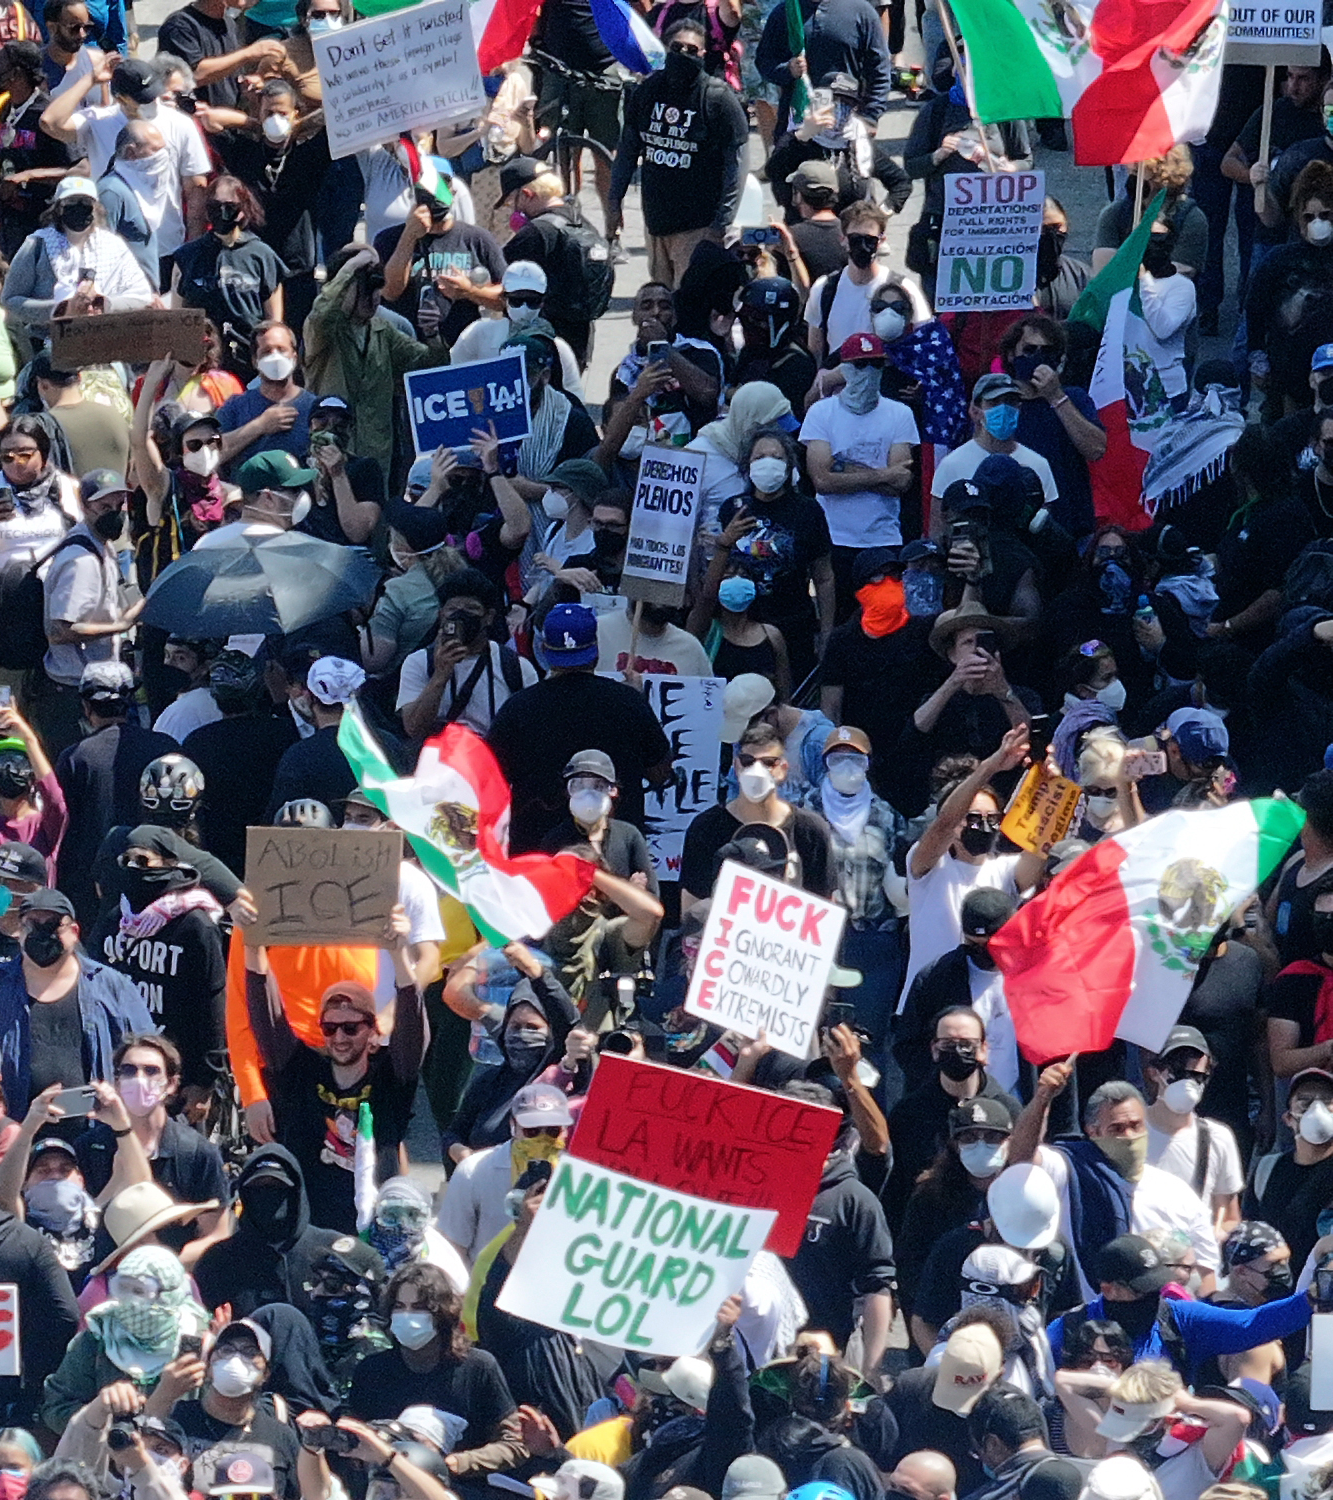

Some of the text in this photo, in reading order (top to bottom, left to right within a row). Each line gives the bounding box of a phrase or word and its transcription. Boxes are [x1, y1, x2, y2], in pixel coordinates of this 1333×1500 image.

[373, 29, 395, 53] Get
[418, 4, 464, 34] Twisted
[1261, 9, 1280, 23] OF
[1285, 9, 1316, 24] OUR
[948, 203, 1042, 217] DEPORTATIONS!
[954, 174, 1038, 206] STOP
[949, 254, 1026, 295] NO
[413, 378, 524, 424] ICE LA!
[635, 483, 695, 517] PLENOS
[262, 873, 388, 928] ICE
[726, 874, 830, 948] FUCK
[716, 916, 821, 976] IGNORANT
[702, 947, 809, 1007] COWARDLY
[695, 979, 810, 1048] EXTREMISTS
[626, 1071, 822, 1146] FUCK ICE
[595, 1108, 650, 1162] LA
[672, 1133, 771, 1185] WANTS
[546, 1163, 753, 1260] NATIONAL
[564, 1231, 716, 1310] GUARD
[560, 1282, 654, 1348] LOL
